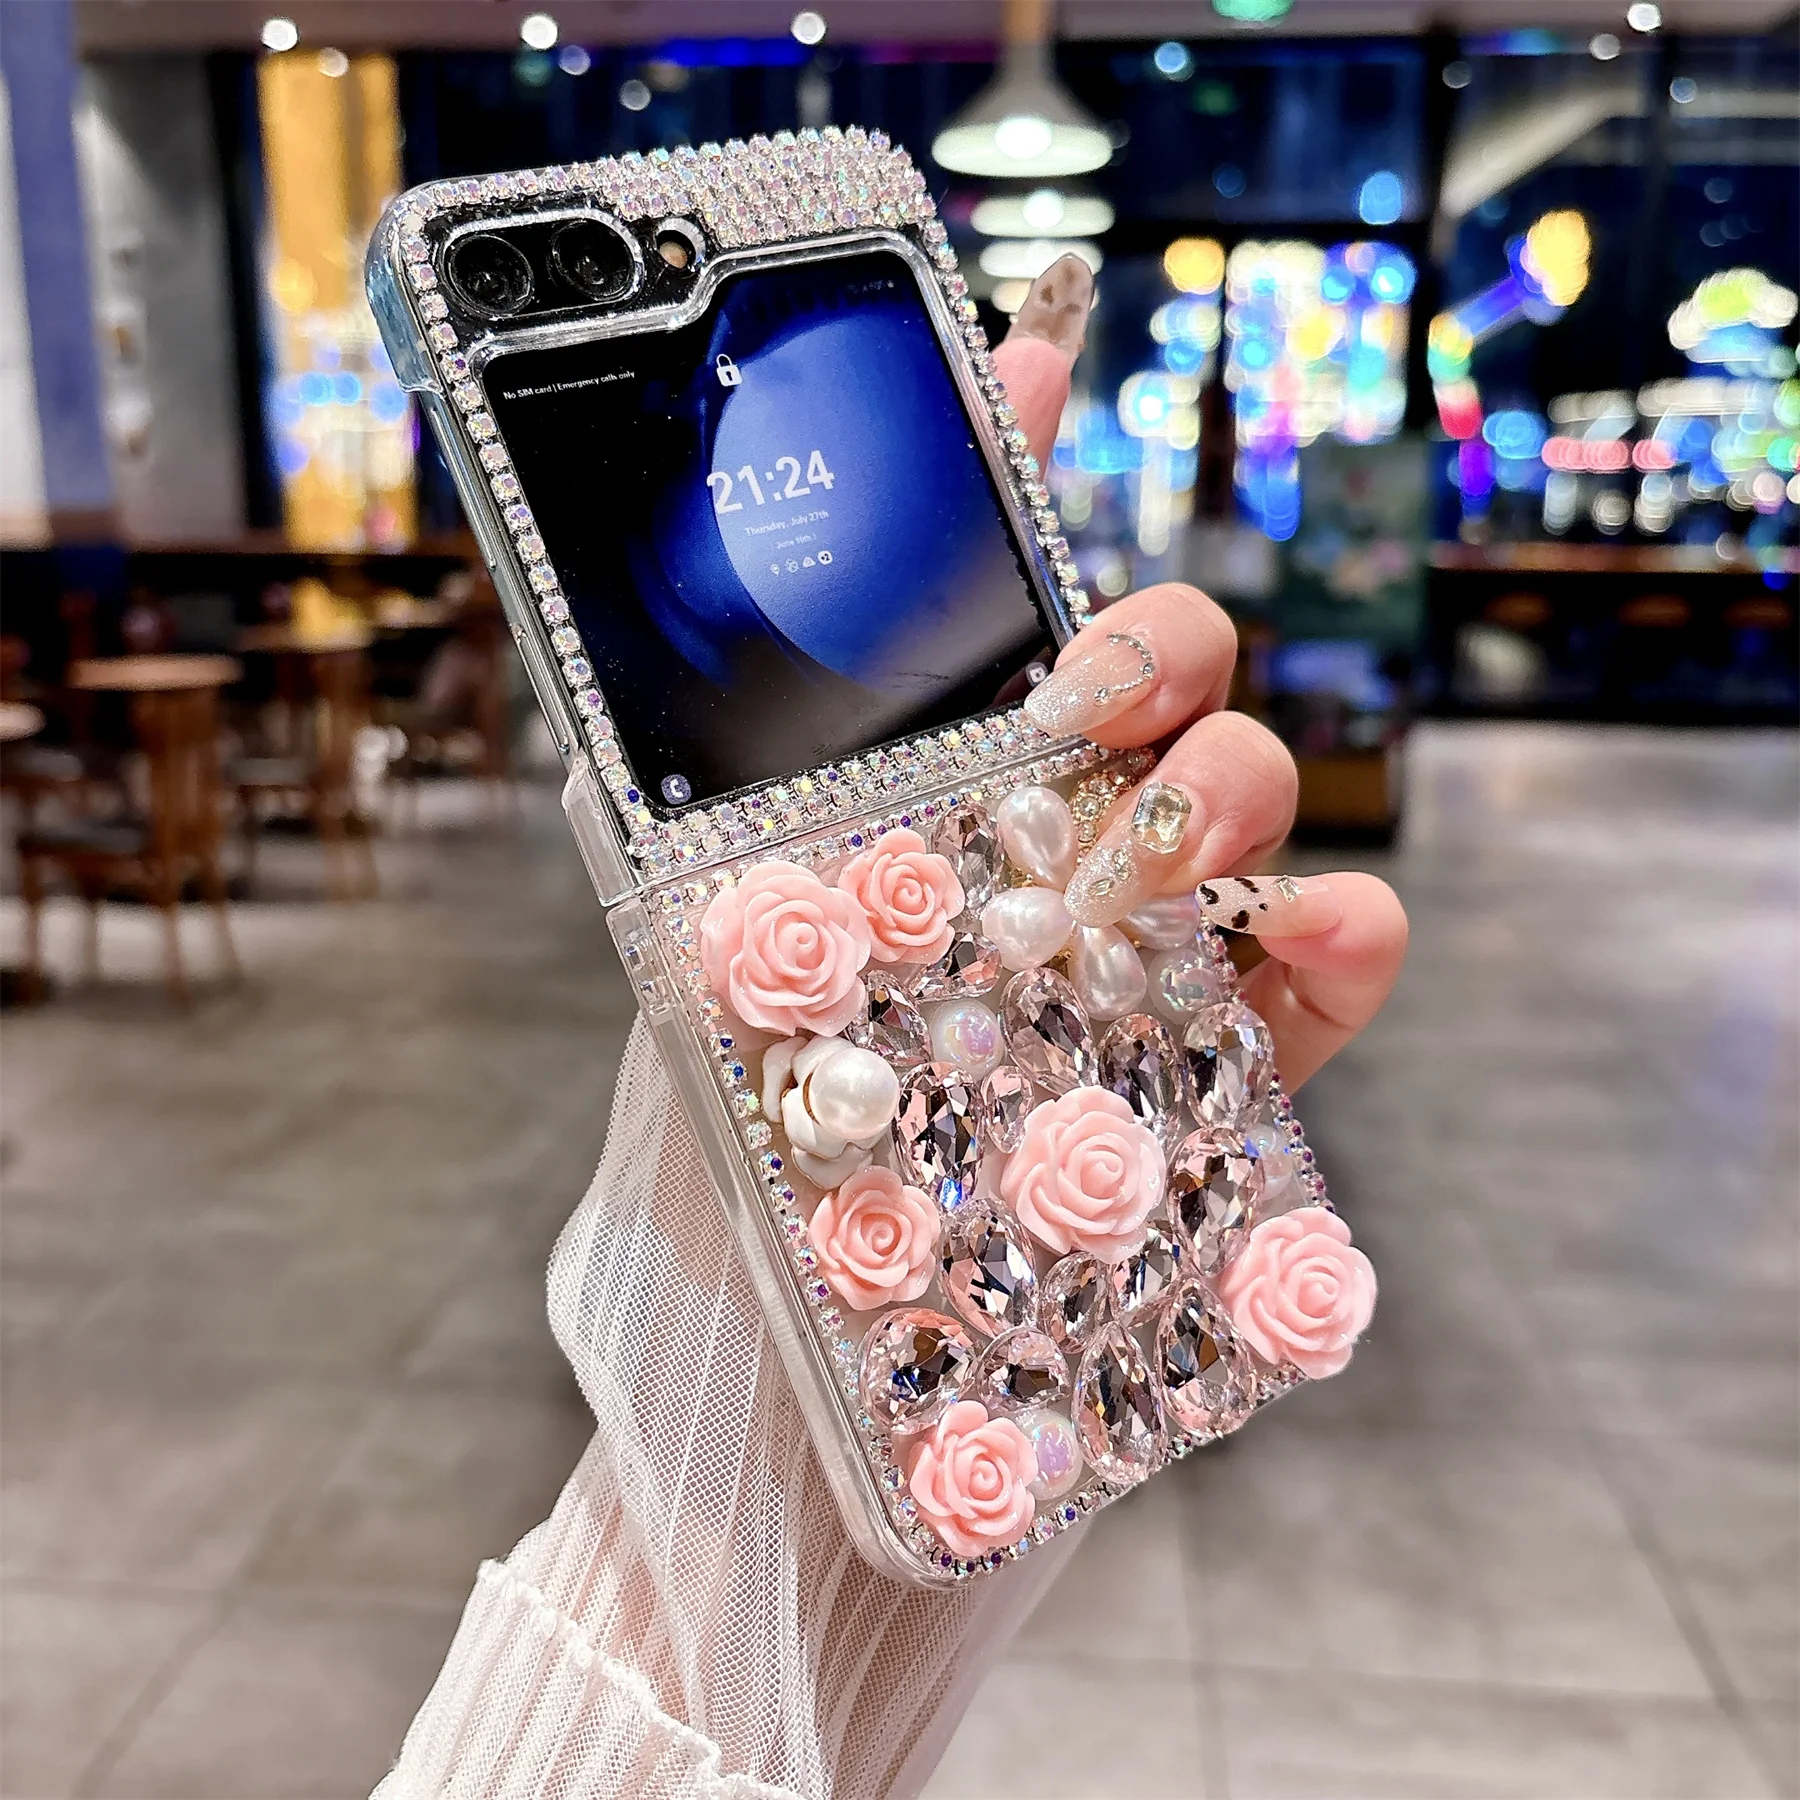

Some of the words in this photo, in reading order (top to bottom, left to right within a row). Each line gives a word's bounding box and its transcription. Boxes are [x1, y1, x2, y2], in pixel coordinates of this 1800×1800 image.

[503, 391, 516, 400] No
[517, 387, 534, 398] SIM
[534, 384, 552, 394] card
[557, 377, 599, 390] Emergency
[600, 373, 618, 383] calls
[618, 370, 635, 379] only
[706, 449, 835, 514] 21:24
[790, 515, 808, 527] July
[808, 510, 829, 522] 27th
